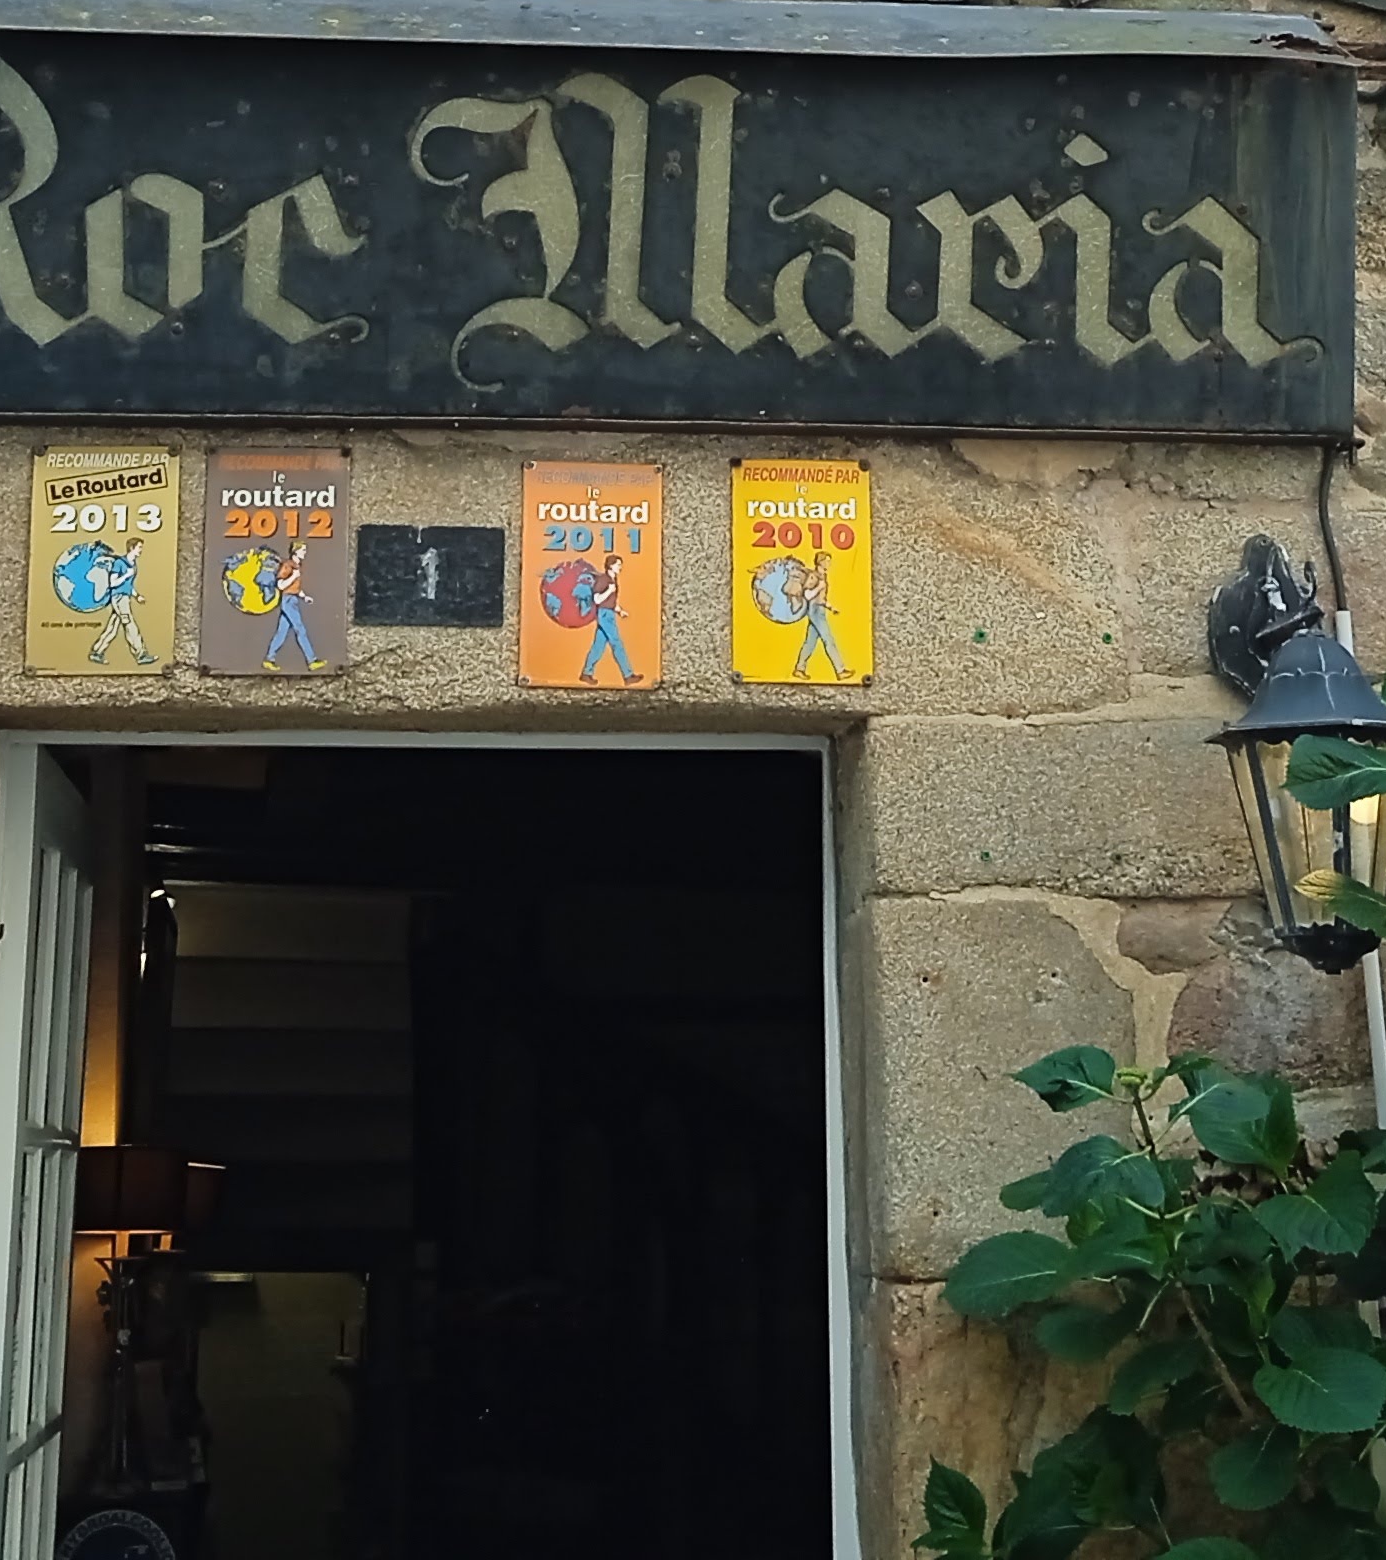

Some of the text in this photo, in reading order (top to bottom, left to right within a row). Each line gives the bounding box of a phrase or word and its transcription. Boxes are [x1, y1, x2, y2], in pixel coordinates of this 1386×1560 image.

[411, 71, 1324, 392] Maria
[142, 453, 170, 468] PAR
[272, 470, 286, 484] le
[743, 465, 860, 484] RECOMMANDÉ PAR
[221, 485, 336, 508] routard
[587, 485, 601, 499] le
[795, 483, 808, 495] le
[50, 503, 163, 533] 2013
[537, 501, 650, 524] routard
[746, 497, 858, 520] routard
[224, 509, 334, 538] 2012
[543, 525, 641, 553] 2011
[752, 521, 855, 551] 2010
